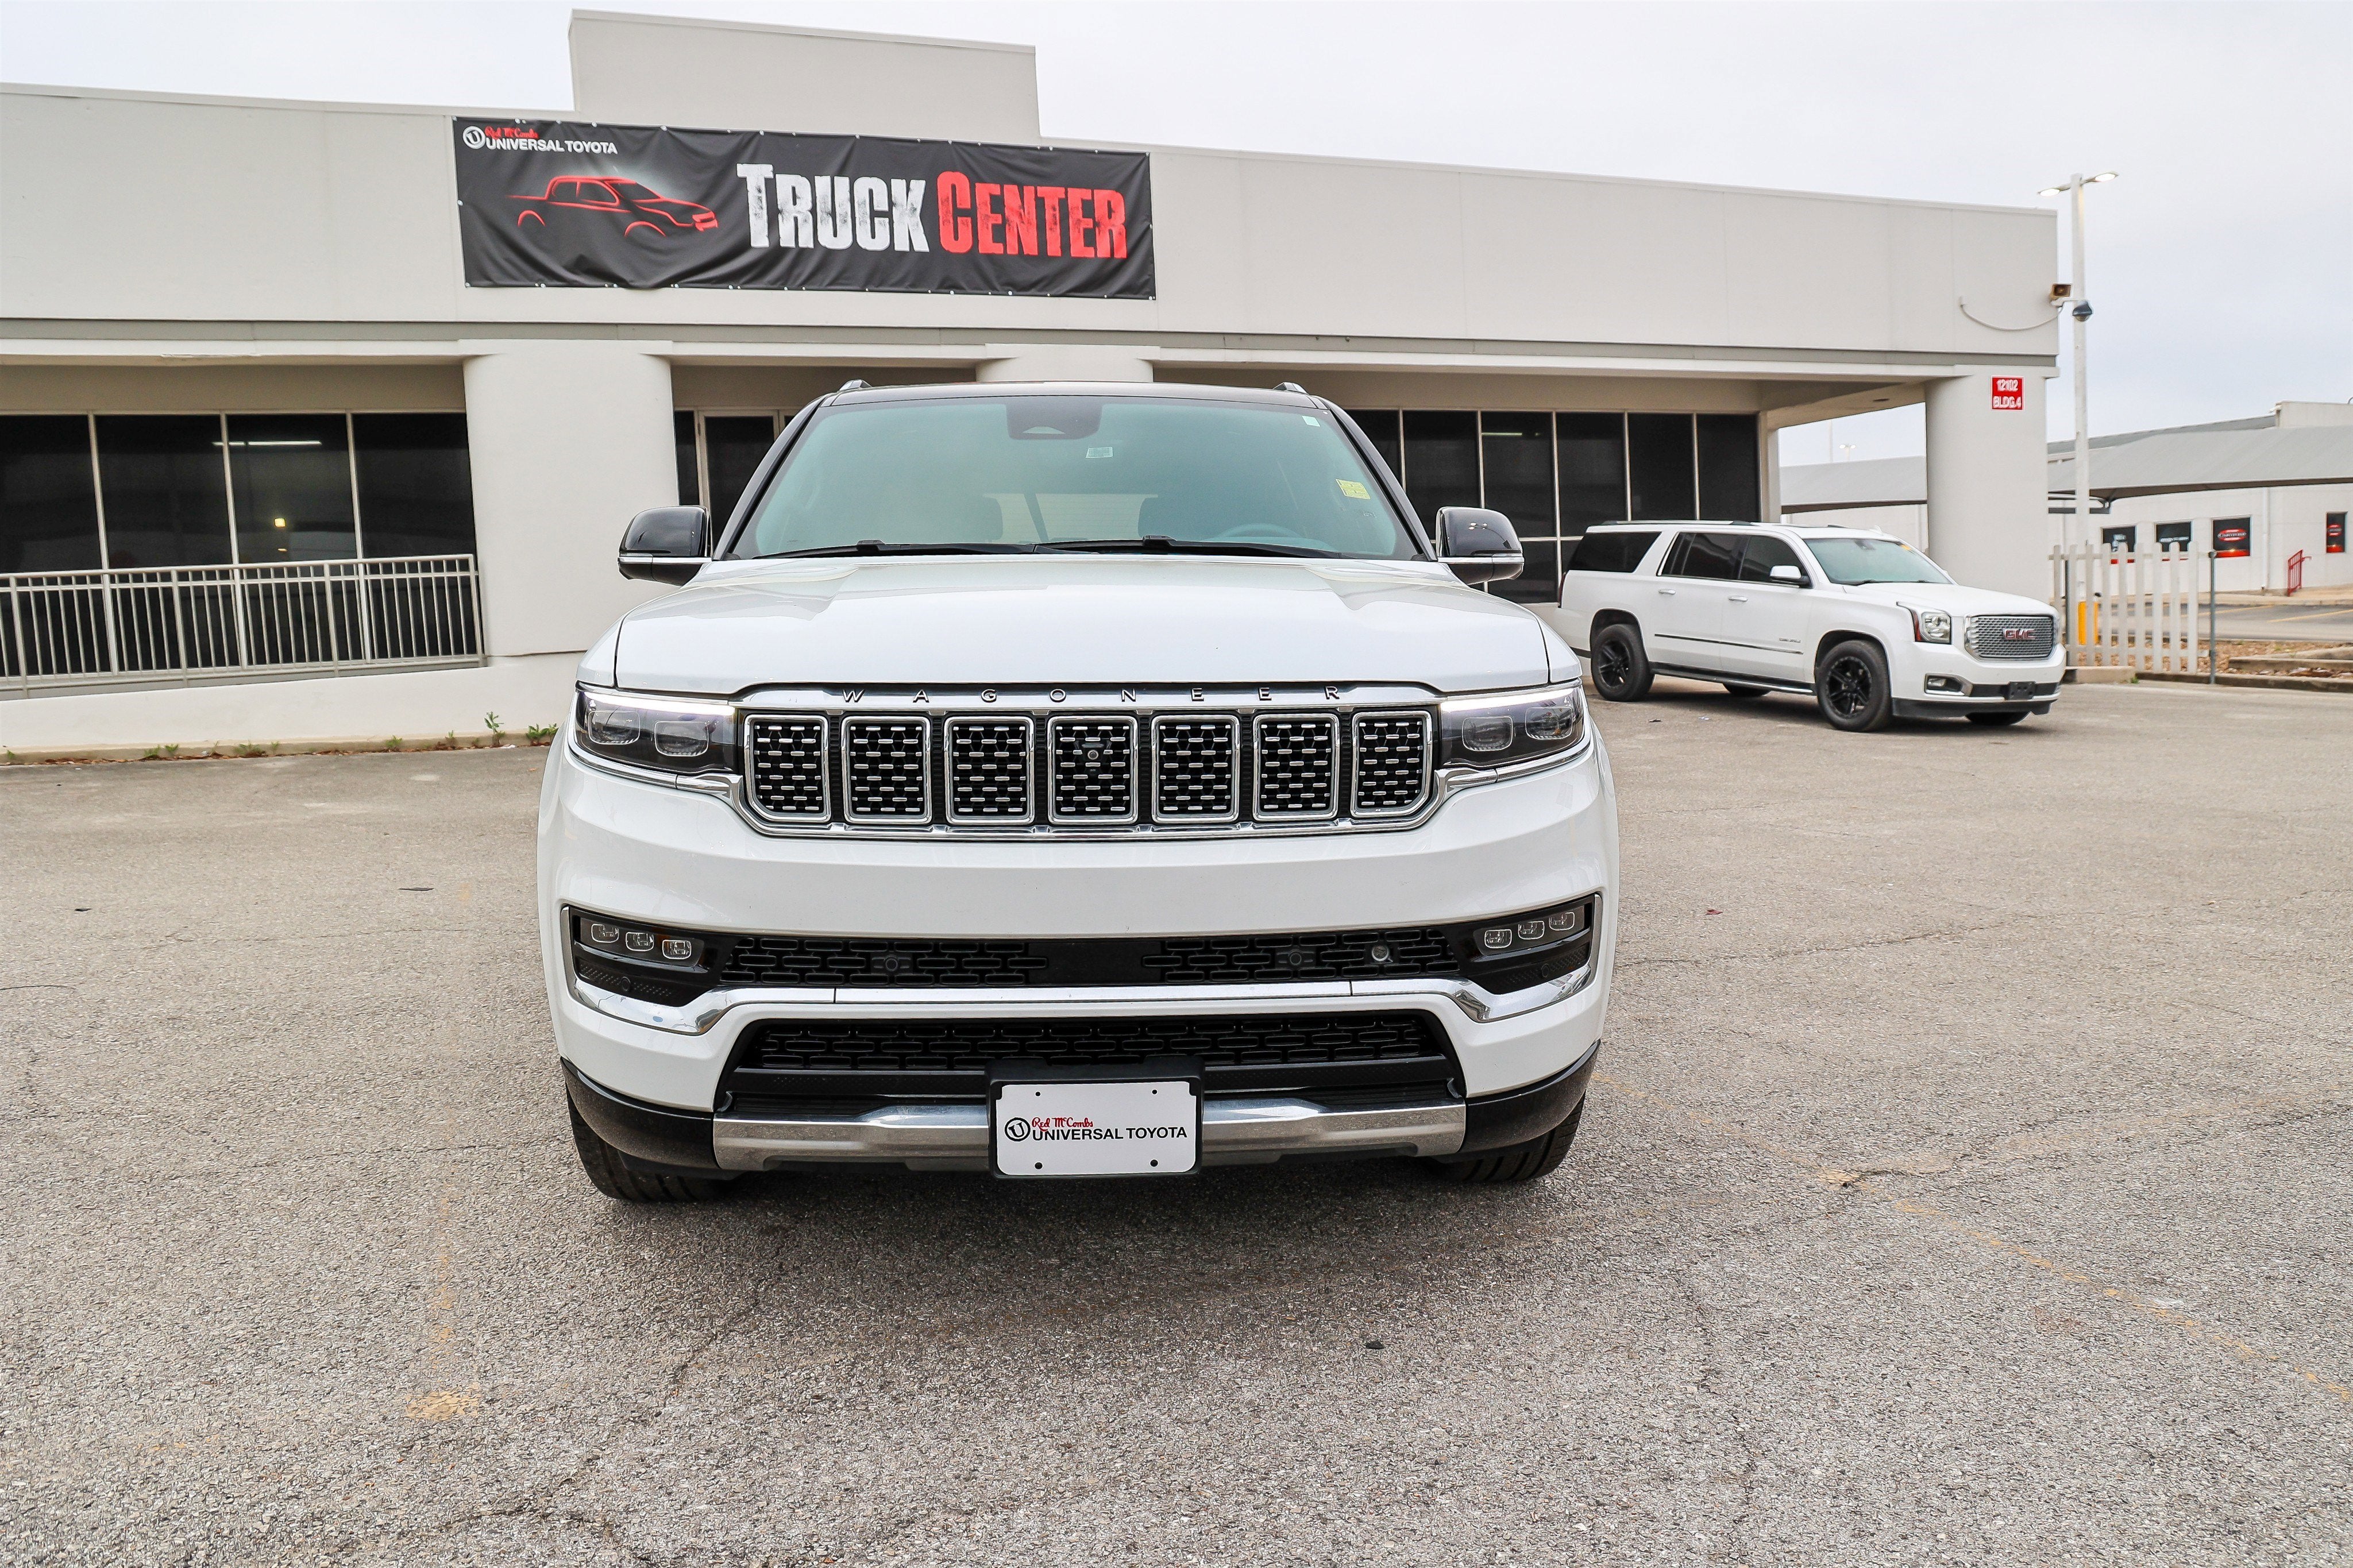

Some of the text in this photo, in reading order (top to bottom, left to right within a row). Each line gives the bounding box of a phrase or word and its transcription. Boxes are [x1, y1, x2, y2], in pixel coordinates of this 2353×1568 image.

[486, 138, 618, 155] UNIVERSAL TOYOTA
[736, 163, 1128, 258] TRUCK CENTER
[1997, 379, 2018, 391] 12102
[2003, 628, 2035, 640] GMC
[842, 686, 1340, 703] WAGONEER
[1032, 1117, 1093, 1131] Red McCombs
[1033, 1126, 1187, 1141] UNIVERSAL TOYOTA
